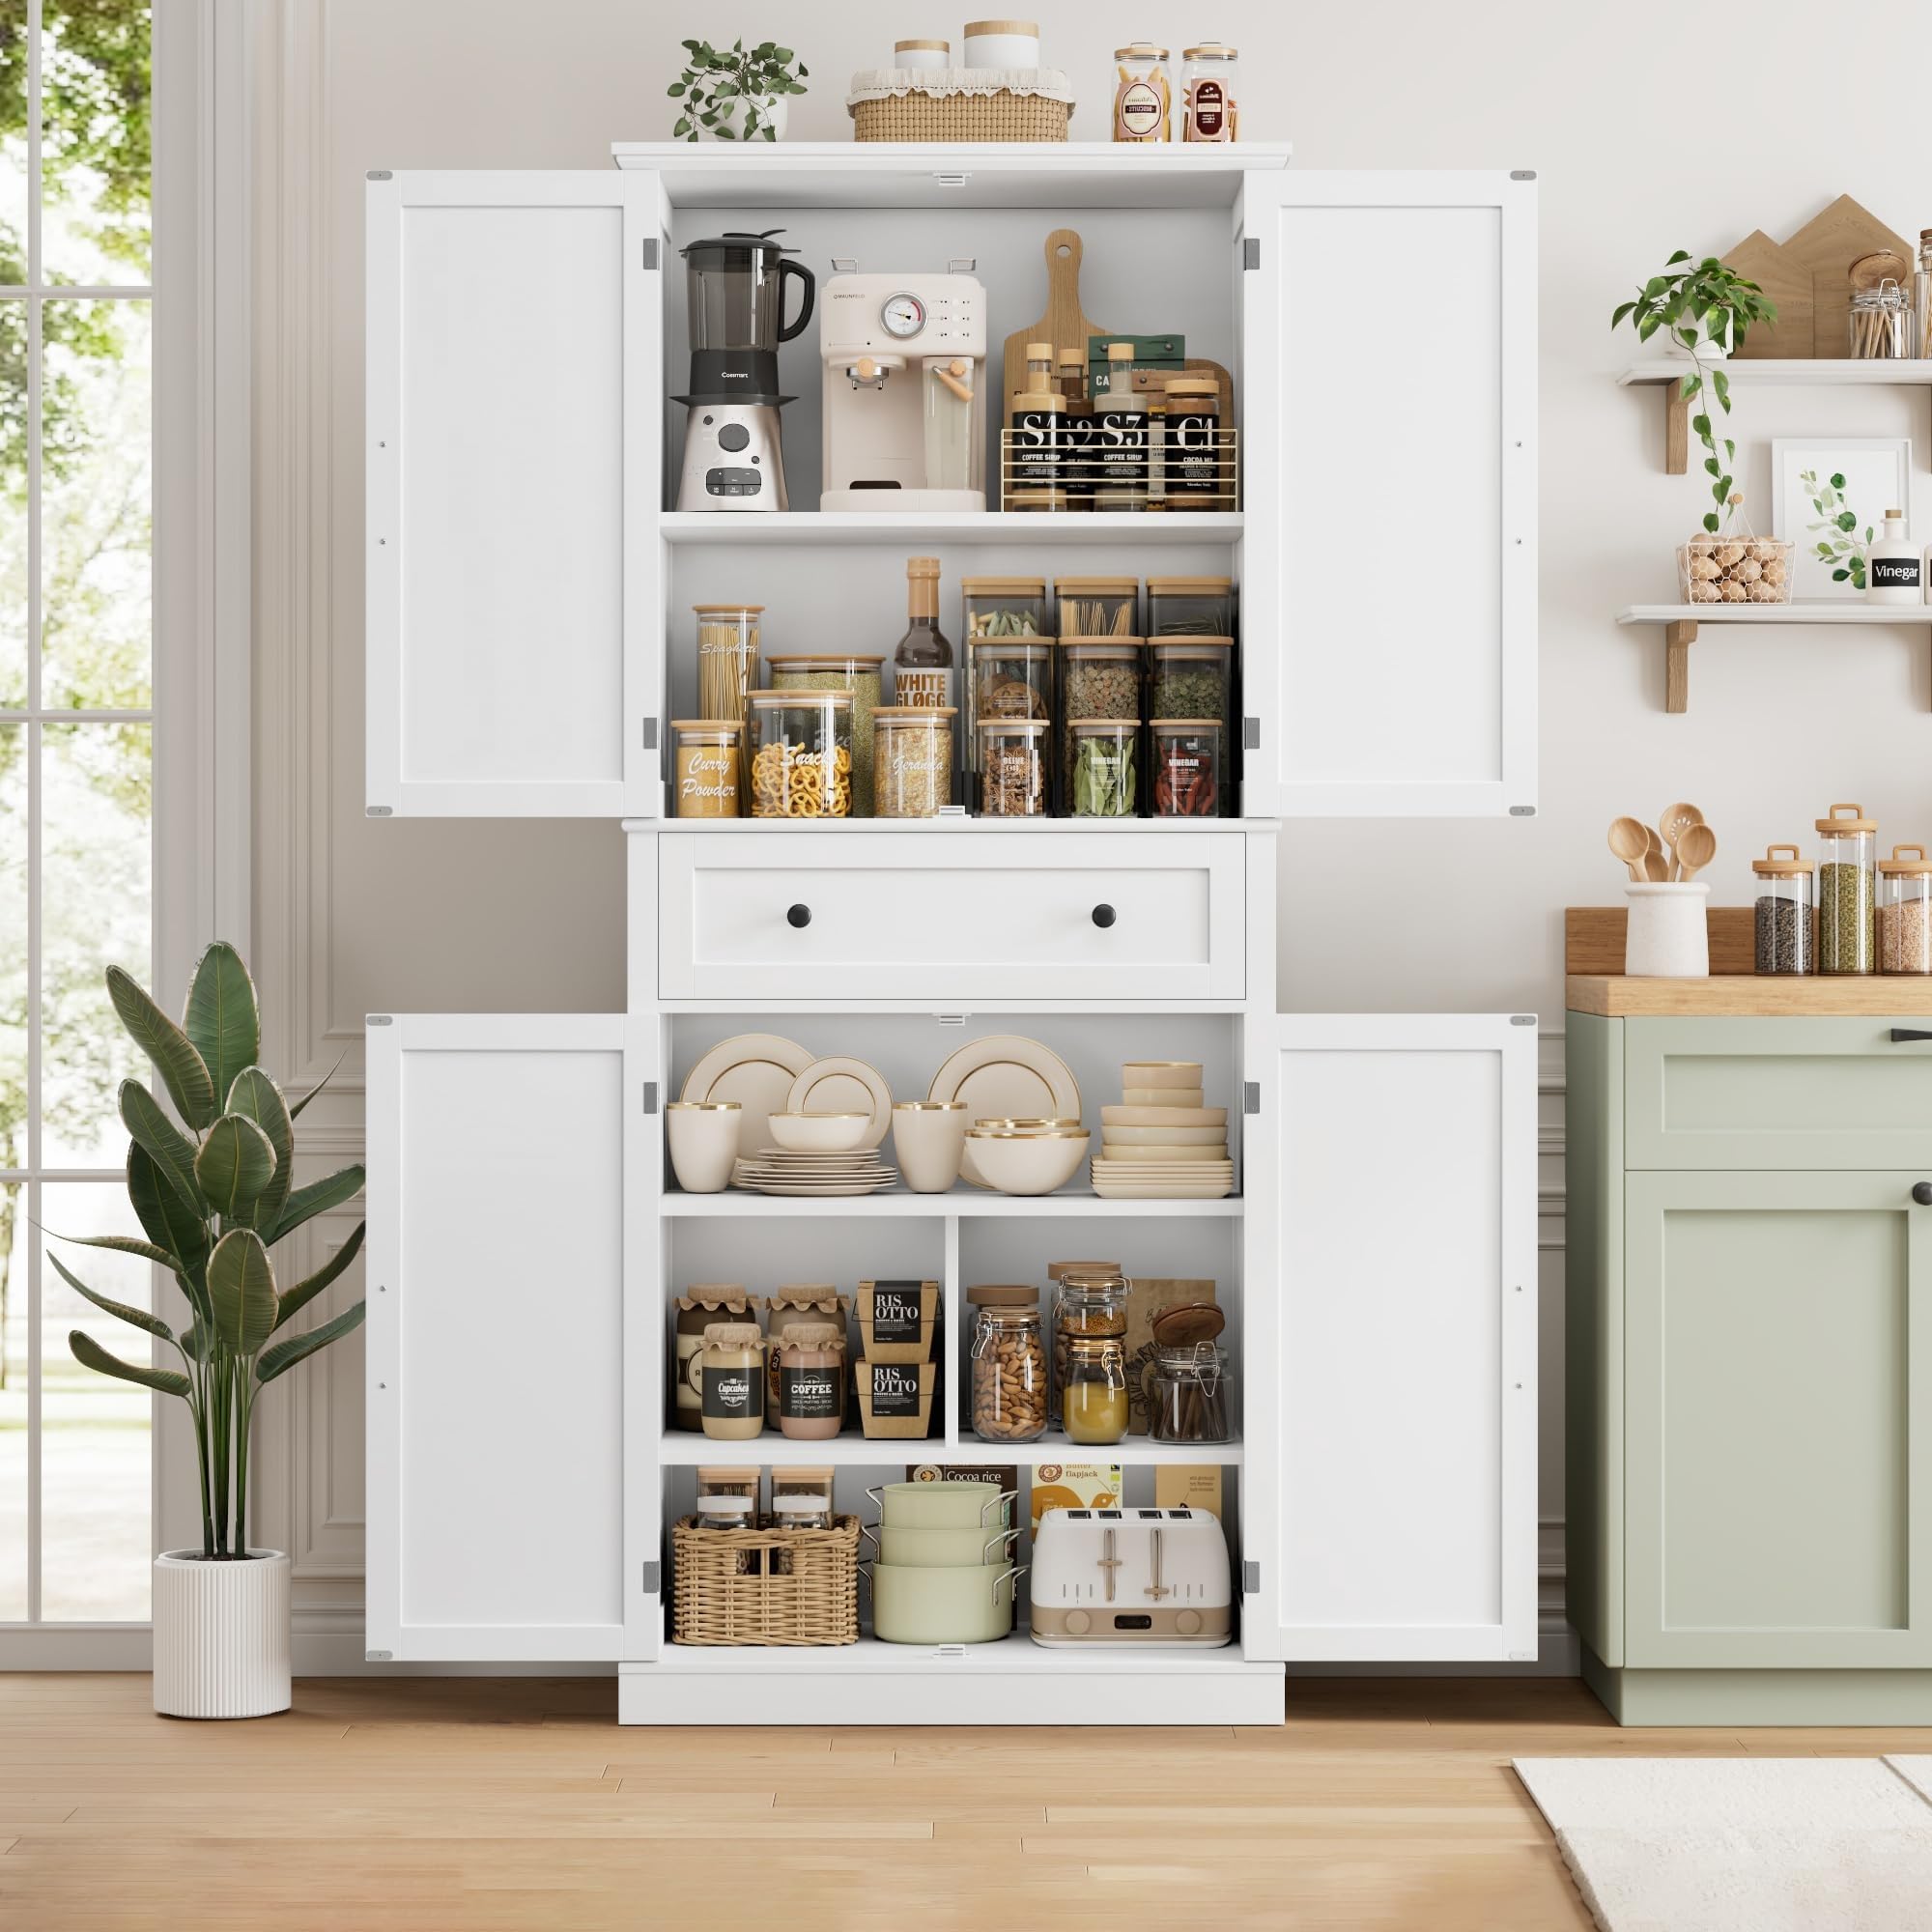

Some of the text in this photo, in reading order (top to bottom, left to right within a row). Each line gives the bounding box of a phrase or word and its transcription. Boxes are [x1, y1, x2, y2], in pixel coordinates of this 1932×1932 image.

[1021, 414, 1057, 447] S1
[1101, 414, 1143, 447] S3
[1875, 565, 1918, 580] Vinegar
[699, 642, 758, 656] Spaghetti
[895, 673, 946, 692] WHITE
[895, 692, 946, 707] GLØGG
[688, 751, 730, 776] Curry
[1090, 756, 1121, 765] VINEGAR
[682, 778, 736, 799] Powder
[875, 1294, 902, 1307] RIS
[875, 1306, 919, 1320] OTTO
[873, 1368, 900, 1380] RIS
[718, 1382, 750, 1395] Cupcakes
[791, 1384, 832, 1394] COFFEE
[873, 1379, 917, 1392] OTTO
[946, 1470, 1002, 1482] Cocoa rice
[1065, 1470, 1098, 1479] flapjack
